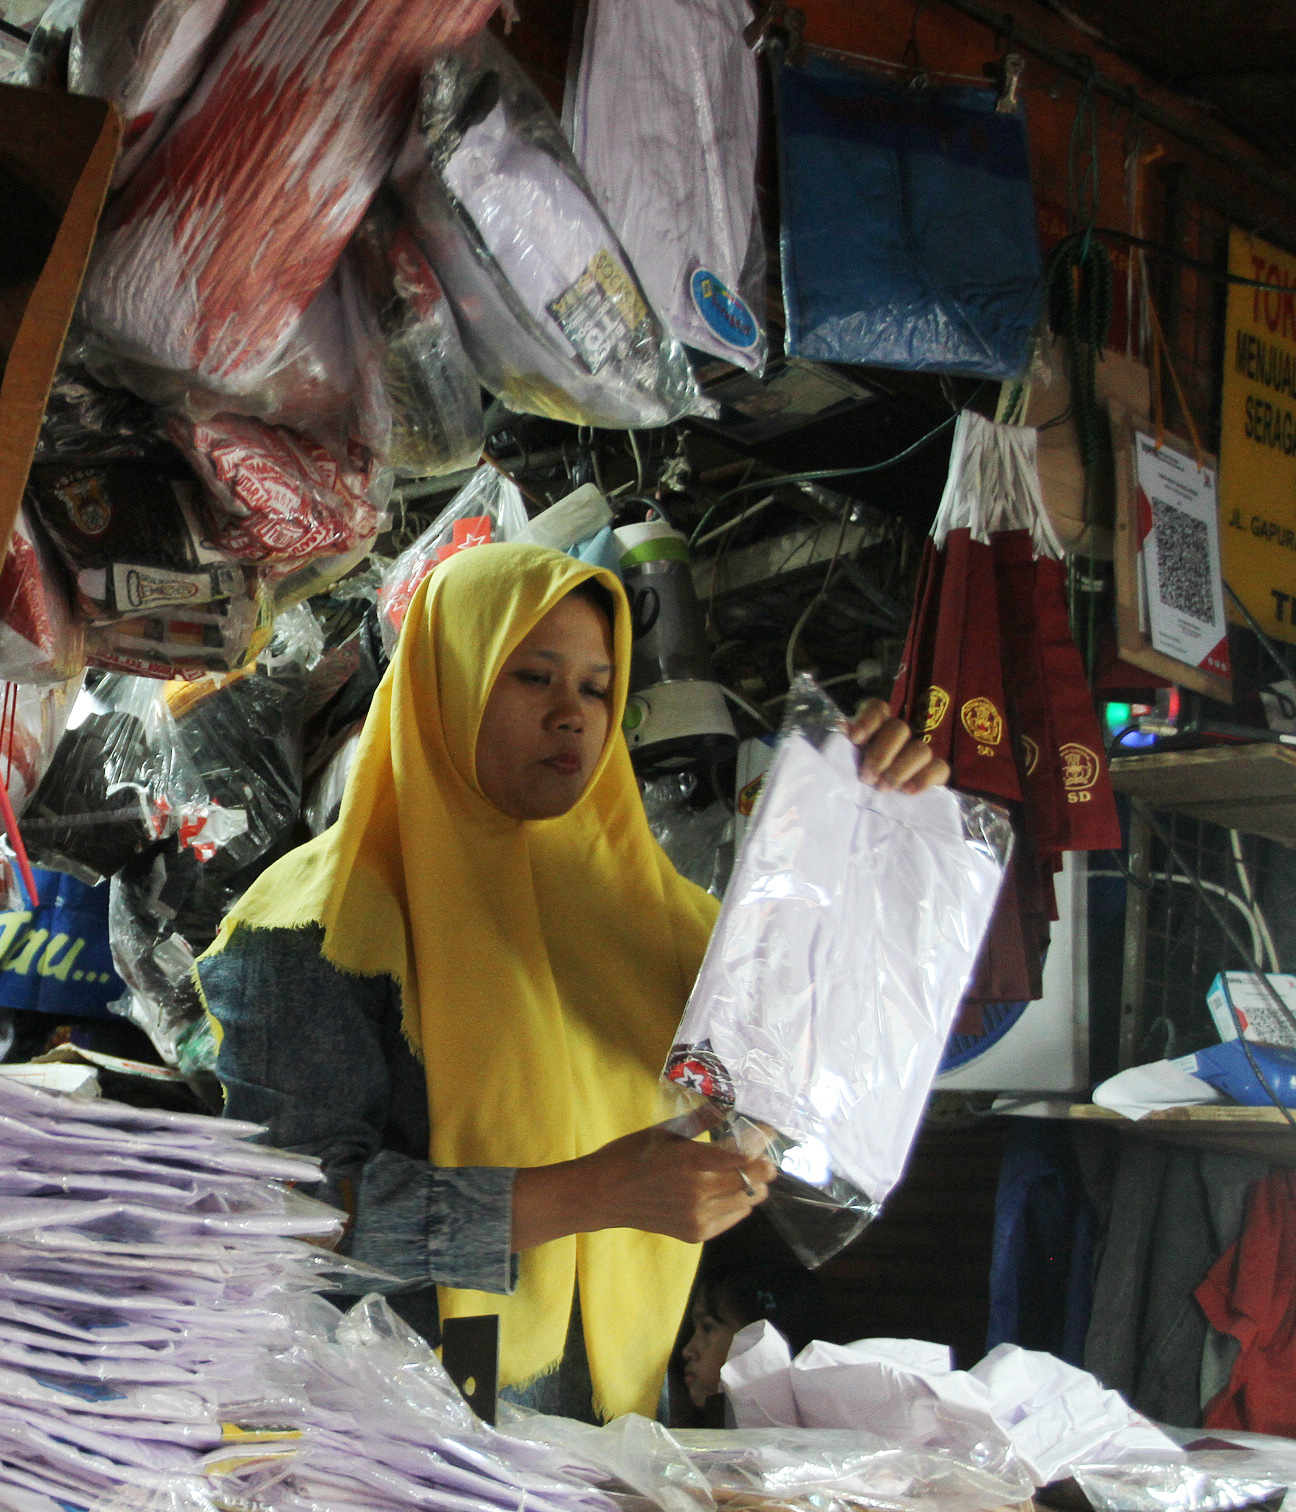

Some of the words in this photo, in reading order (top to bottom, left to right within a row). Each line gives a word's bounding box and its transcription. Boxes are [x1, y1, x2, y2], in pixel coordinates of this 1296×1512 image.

[237, 472, 265, 507] UTARA
[977, 744, 994, 758] SD
[1067, 790, 1092, 804] SD
